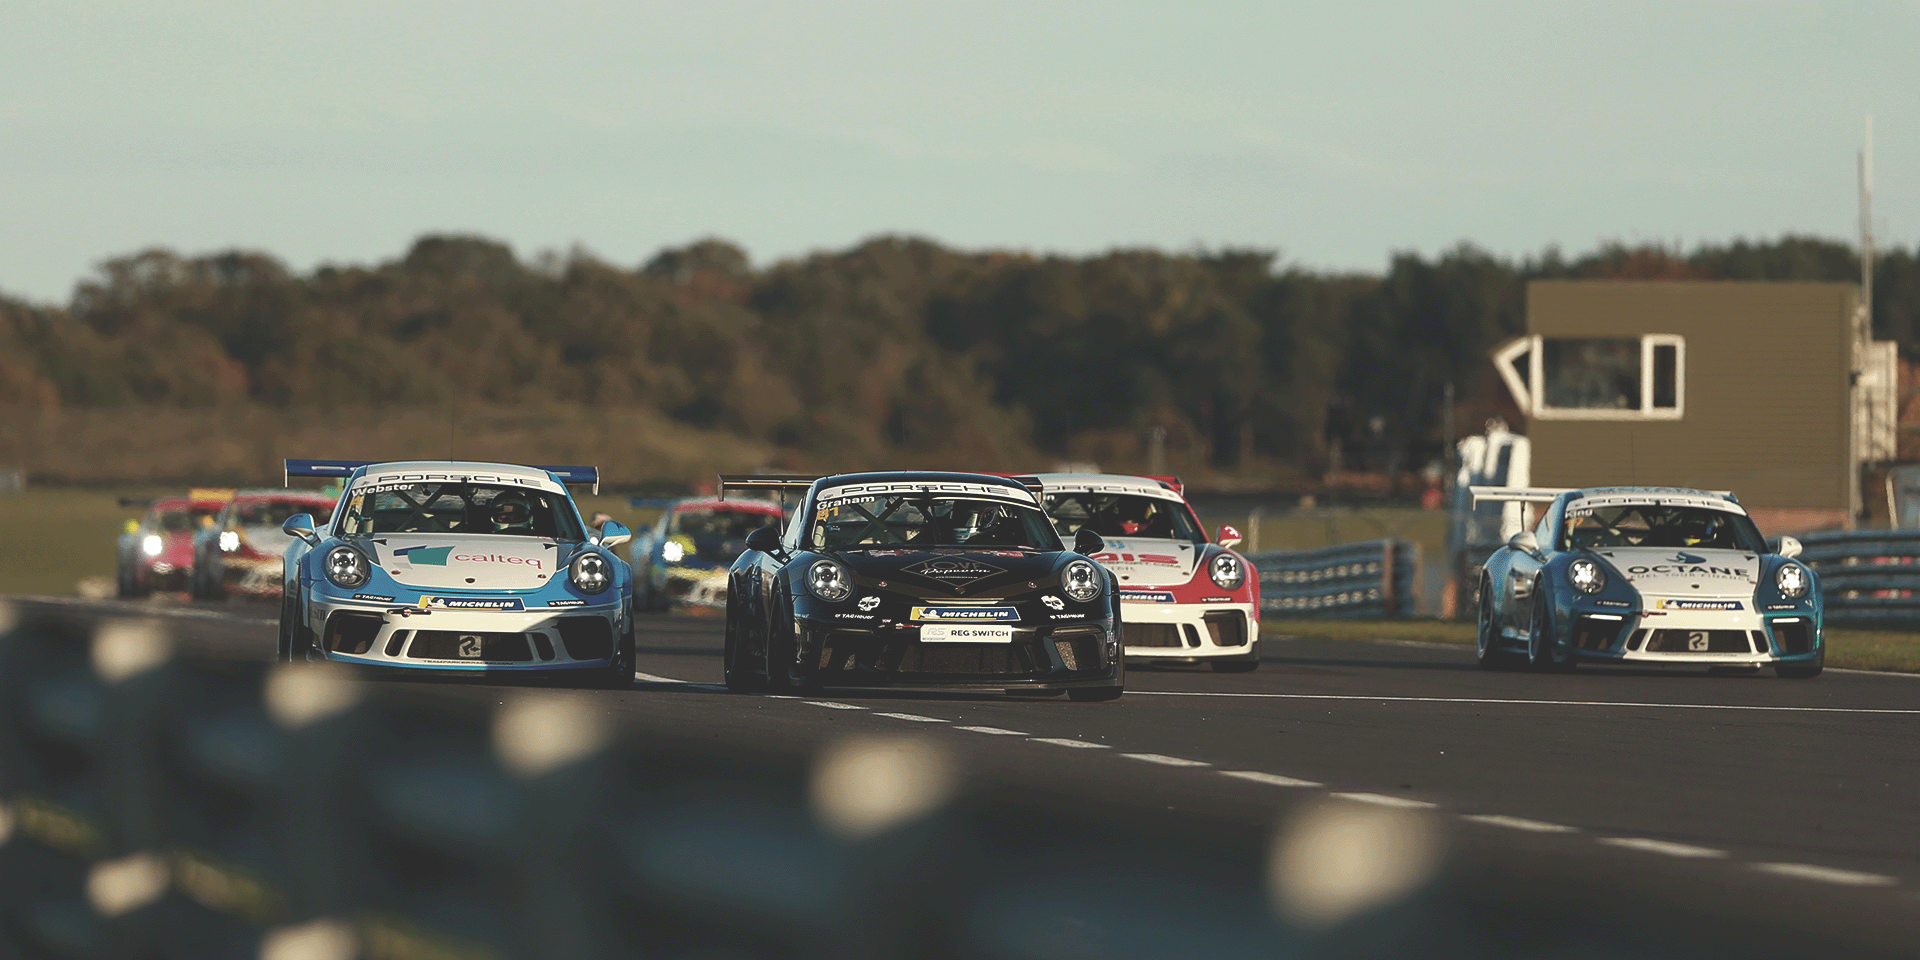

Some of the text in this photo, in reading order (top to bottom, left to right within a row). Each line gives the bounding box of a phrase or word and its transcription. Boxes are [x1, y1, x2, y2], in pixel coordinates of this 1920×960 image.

[378, 475, 542, 488] PORSCHE
[351, 484, 415, 498] Webster
[841, 484, 1010, 496] PORSCHE
[1043, 484, 1162, 496] ORSCHE
[816, 496, 875, 511] Graham
[455, 554, 542, 570] calteq
[1627, 564, 1750, 578] OCTANE
[448, 599, 516, 609] MICHELIN
[1680, 602, 1737, 610] MICHELIN
[950, 629, 1009, 637] REG SWITCH
